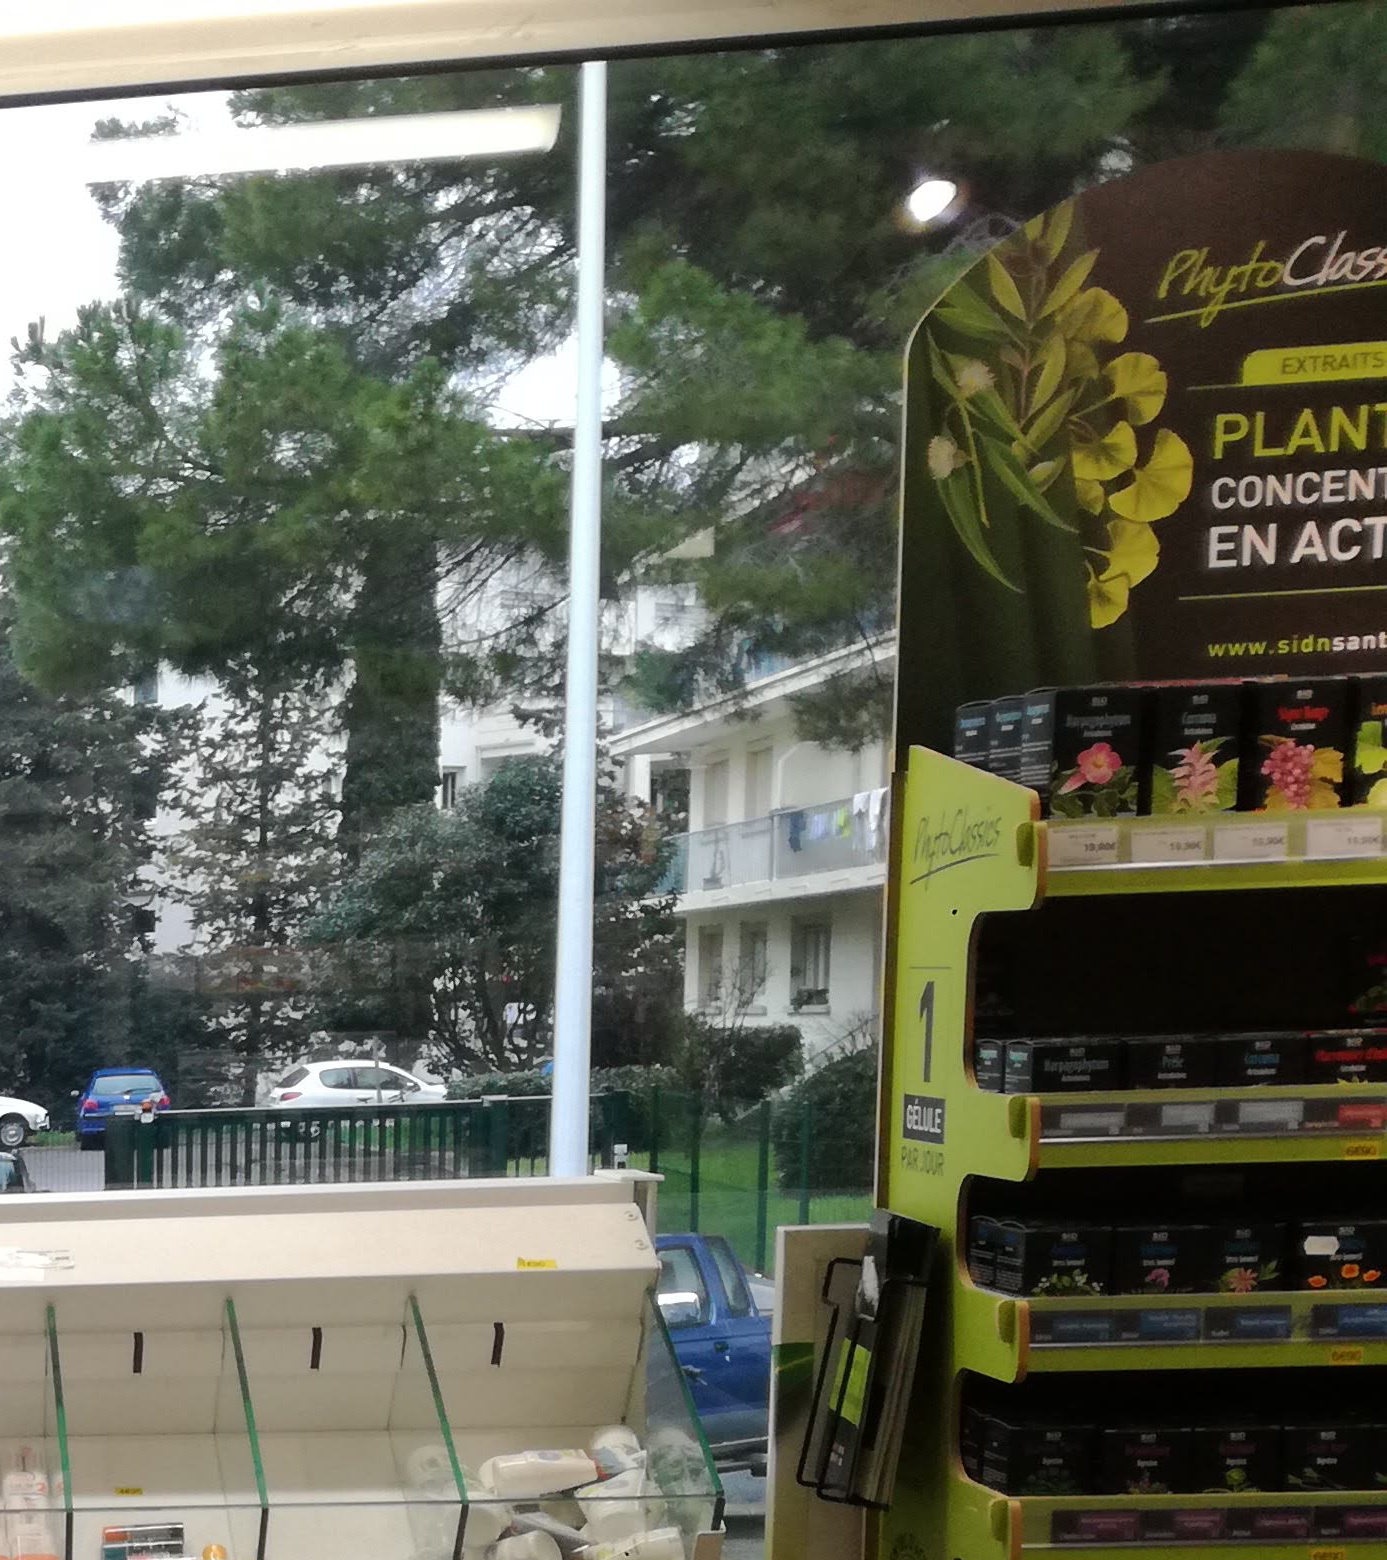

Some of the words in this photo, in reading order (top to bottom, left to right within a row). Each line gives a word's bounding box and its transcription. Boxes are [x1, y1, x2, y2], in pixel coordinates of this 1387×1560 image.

[1282, 352, 1385, 375] EXTRAITS
[1208, 523, 1278, 569] EN
[919, 981, 935, 1082] 1
